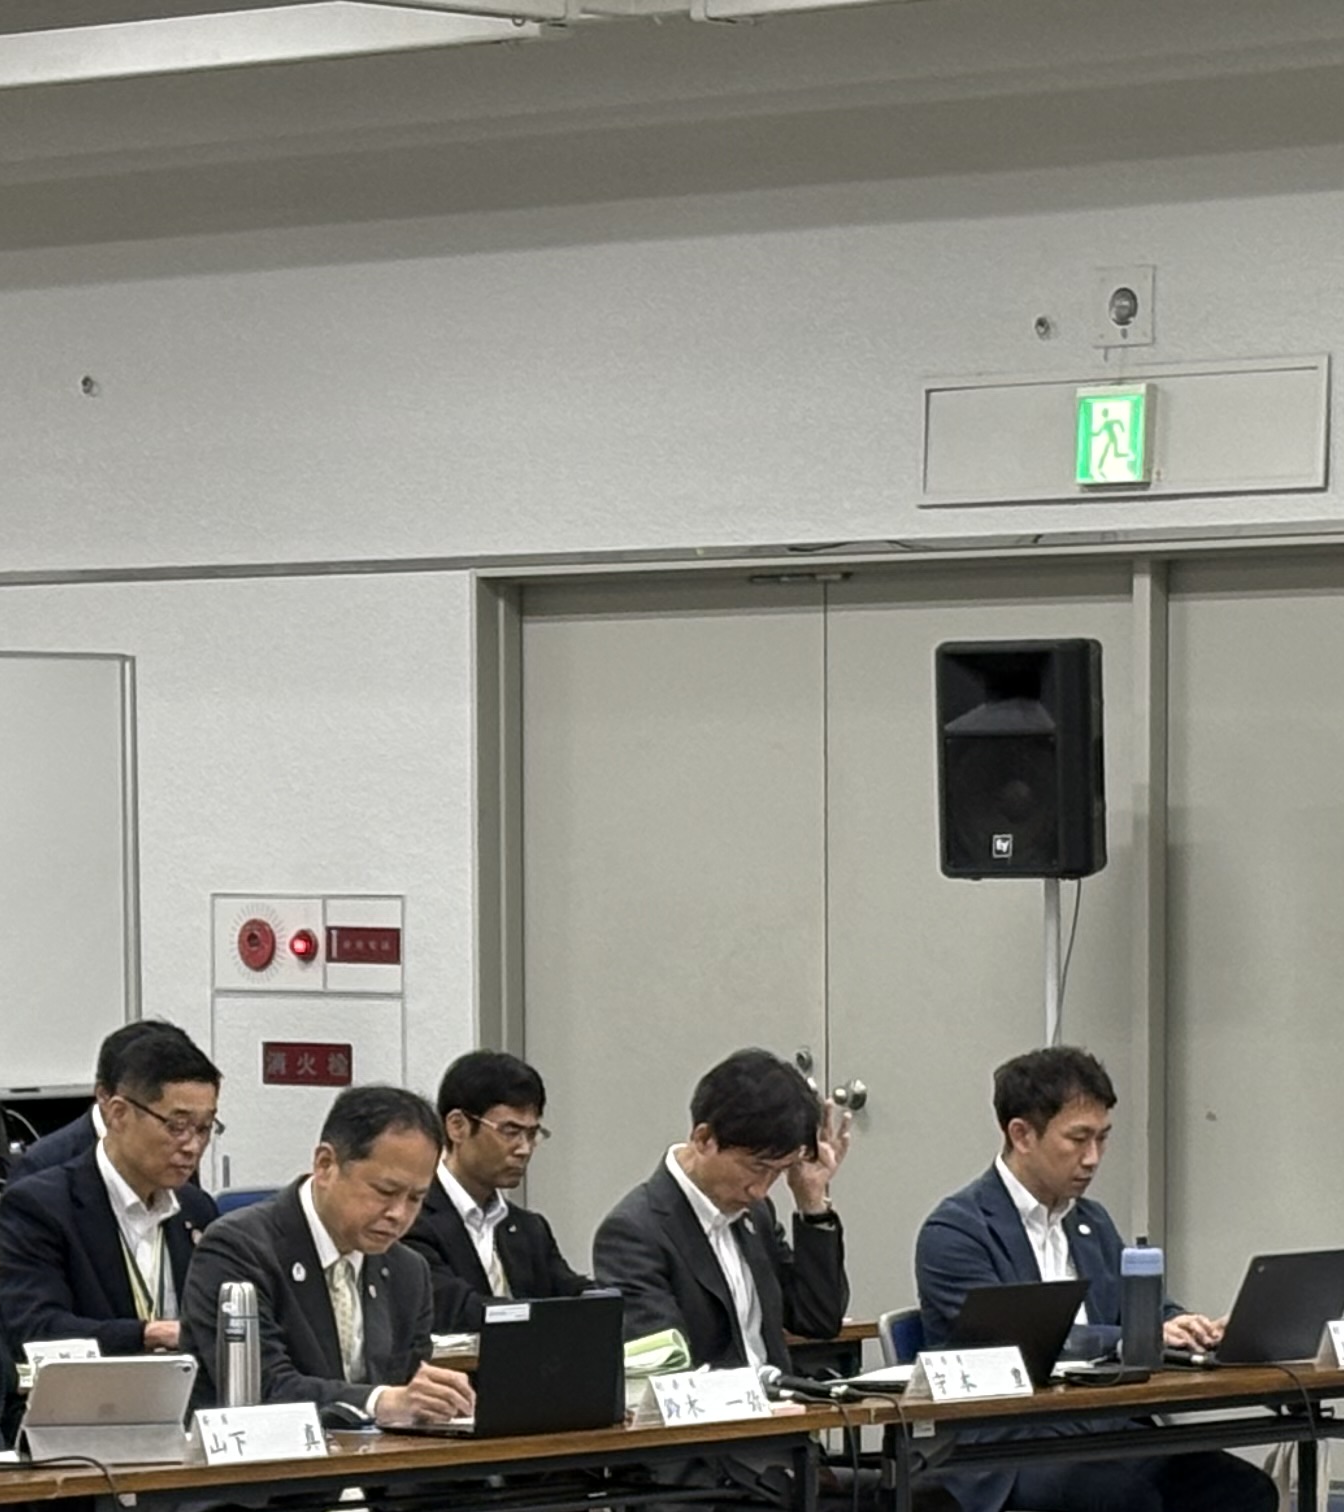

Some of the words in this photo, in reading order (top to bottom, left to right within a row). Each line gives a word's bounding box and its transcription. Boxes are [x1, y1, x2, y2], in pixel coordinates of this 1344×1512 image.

[267, 1052, 349, 1076] 消火栓
[210, 1430, 246, 1456] 山下
